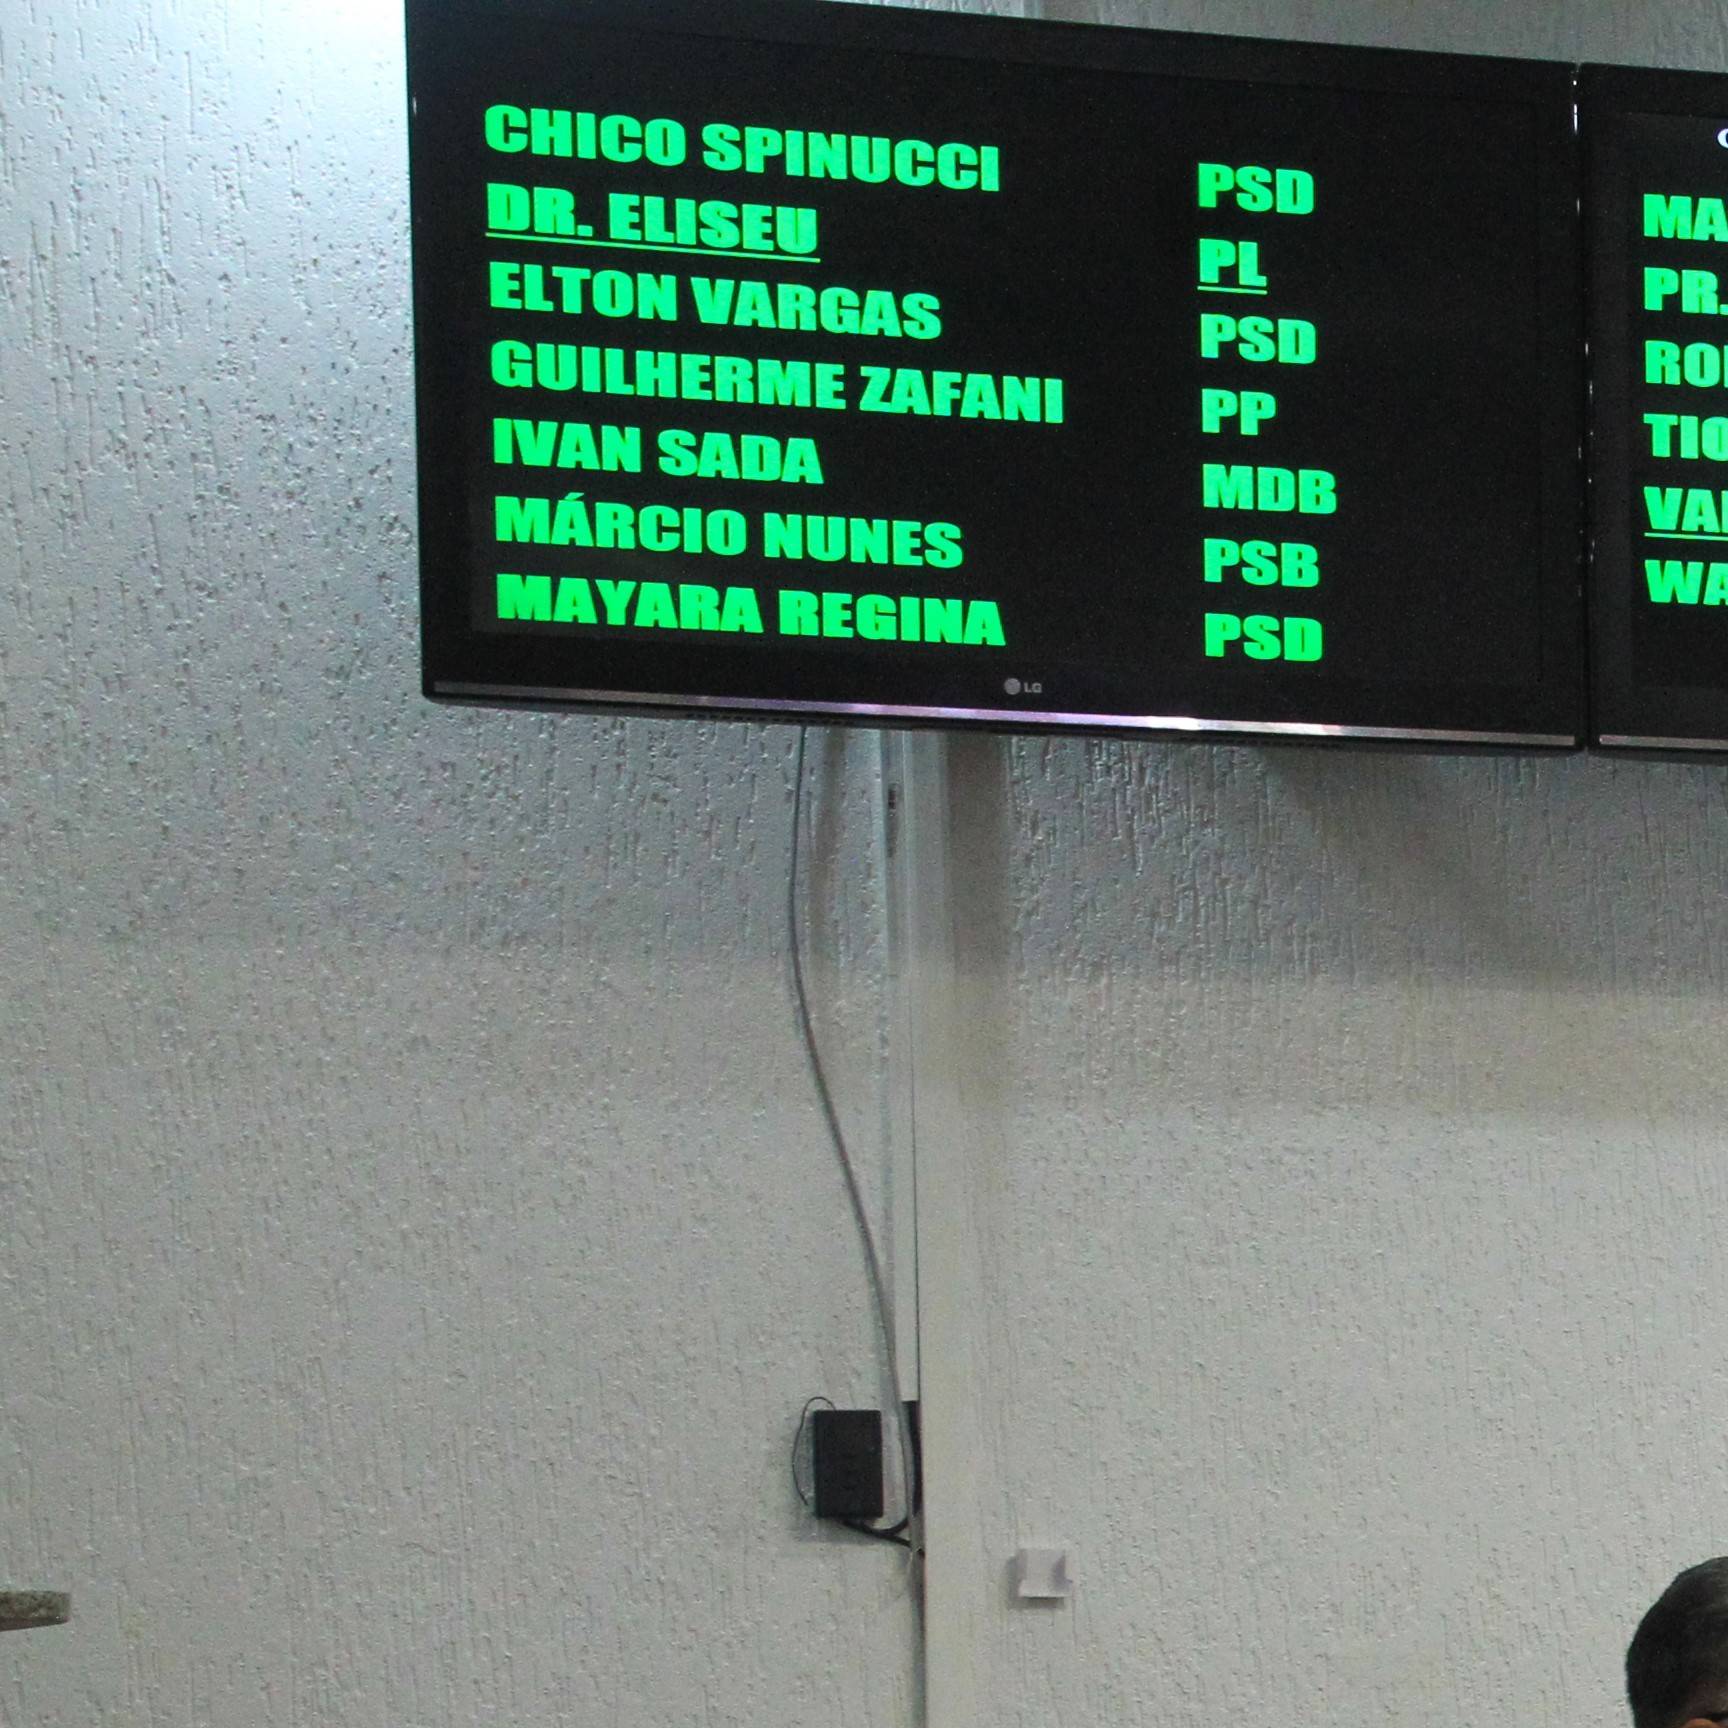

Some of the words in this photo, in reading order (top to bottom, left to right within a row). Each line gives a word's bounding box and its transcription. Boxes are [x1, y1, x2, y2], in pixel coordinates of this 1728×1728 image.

[484, 104, 687, 167] CHICO
[701, 122, 1000, 192] SPINUCCI
[1197, 162, 1315, 214] PSD
[486, 183, 594, 237] DR.
[608, 192, 818, 254] ELISEU
[1198, 237, 1268, 287] PL
[489, 260, 678, 321] ELTON
[689, 276, 943, 339] VARGAS
[1200, 312, 1317, 364] PSD
[490, 339, 847, 409] GUILHERME
[858, 365, 1064, 423] ZAFANI
[1201, 387, 1277, 436] PP
[492, 417, 642, 472] IVAN
[656, 428, 825, 484] SADA
[1202, 463, 1338, 514] MDB
[494, 491, 748, 555] MÁRCIO
[763, 511, 964, 568] NUNES
[1203, 537, 1320, 587] PSB
[496, 573, 765, 633] MAYARA
[778, 589, 1007, 646] REGINA
[1204, 612, 1323, 661] PSD
[1023, 682, 1042, 694] LG
